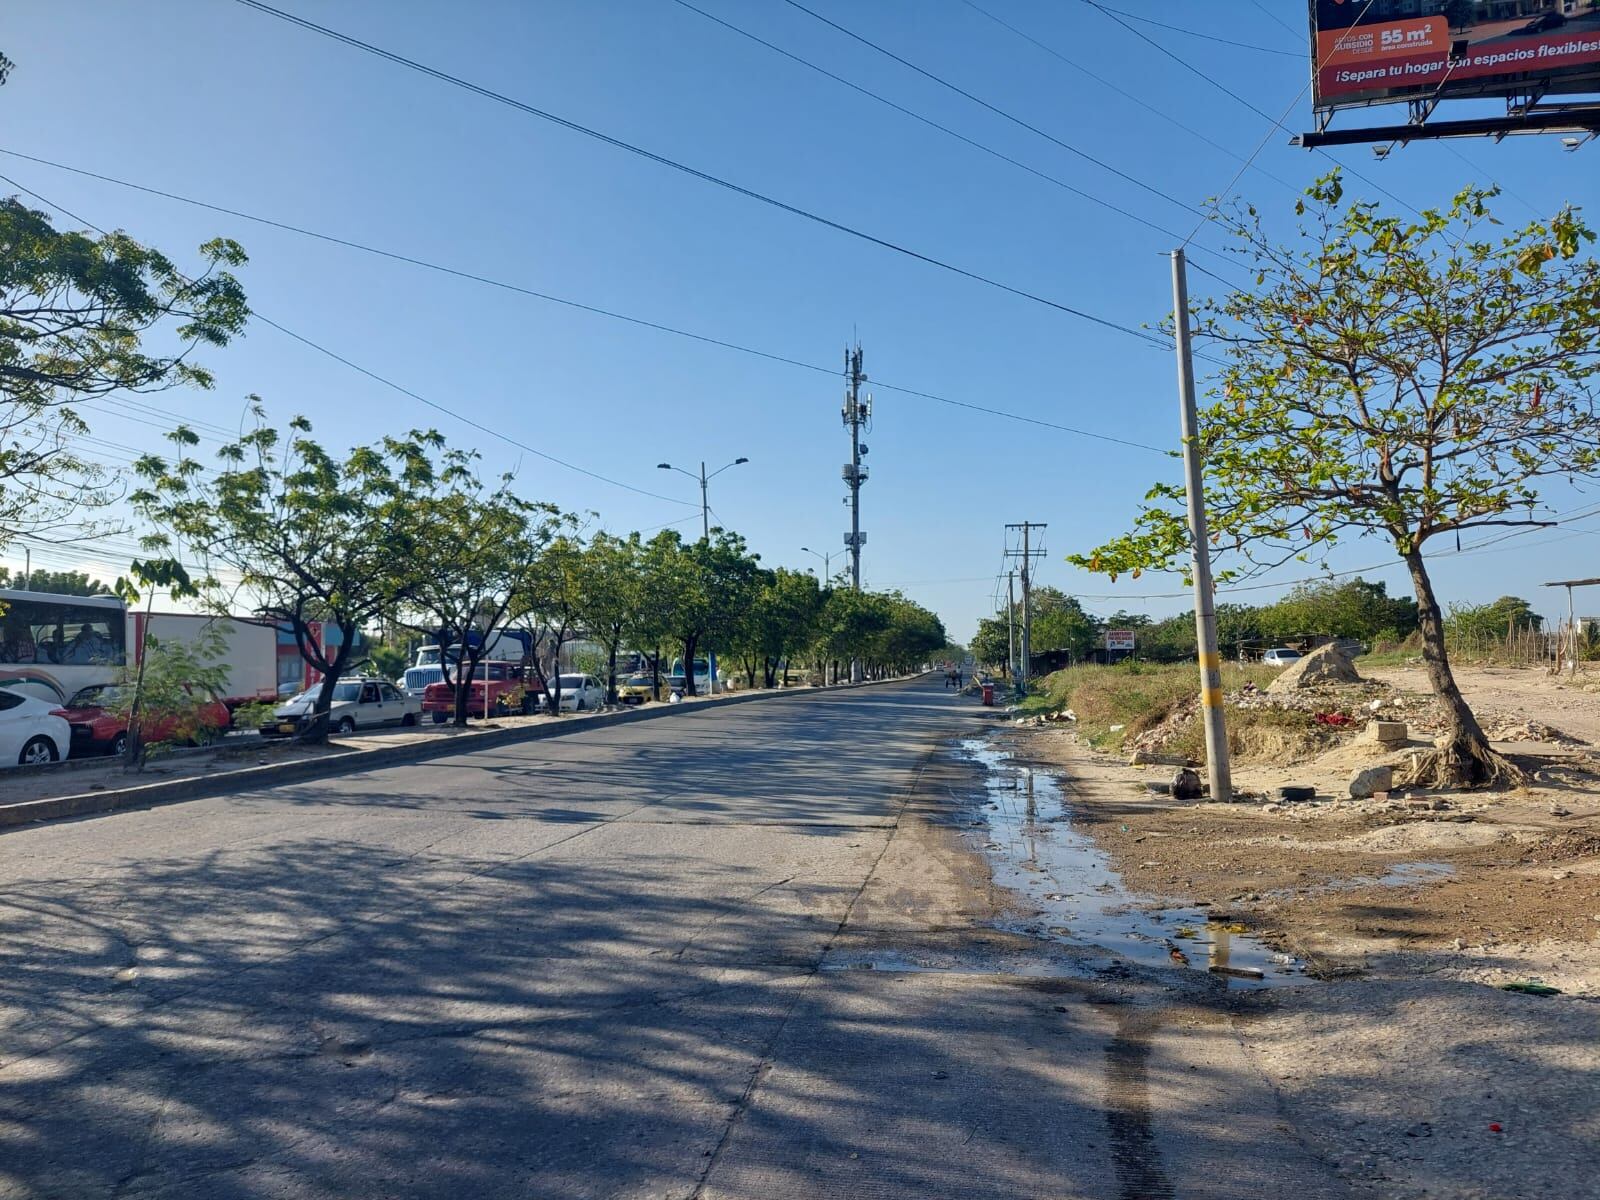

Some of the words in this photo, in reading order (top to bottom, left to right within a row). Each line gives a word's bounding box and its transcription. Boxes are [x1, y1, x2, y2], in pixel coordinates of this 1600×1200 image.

[1381, 29, 1404, 45] 55
[1336, 68, 1386, 82] ¡Separa
[1389, 65, 1402, 76] tu
[1405, 61, 1444, 75] hogar
[1474, 49, 1535, 66] espacios
